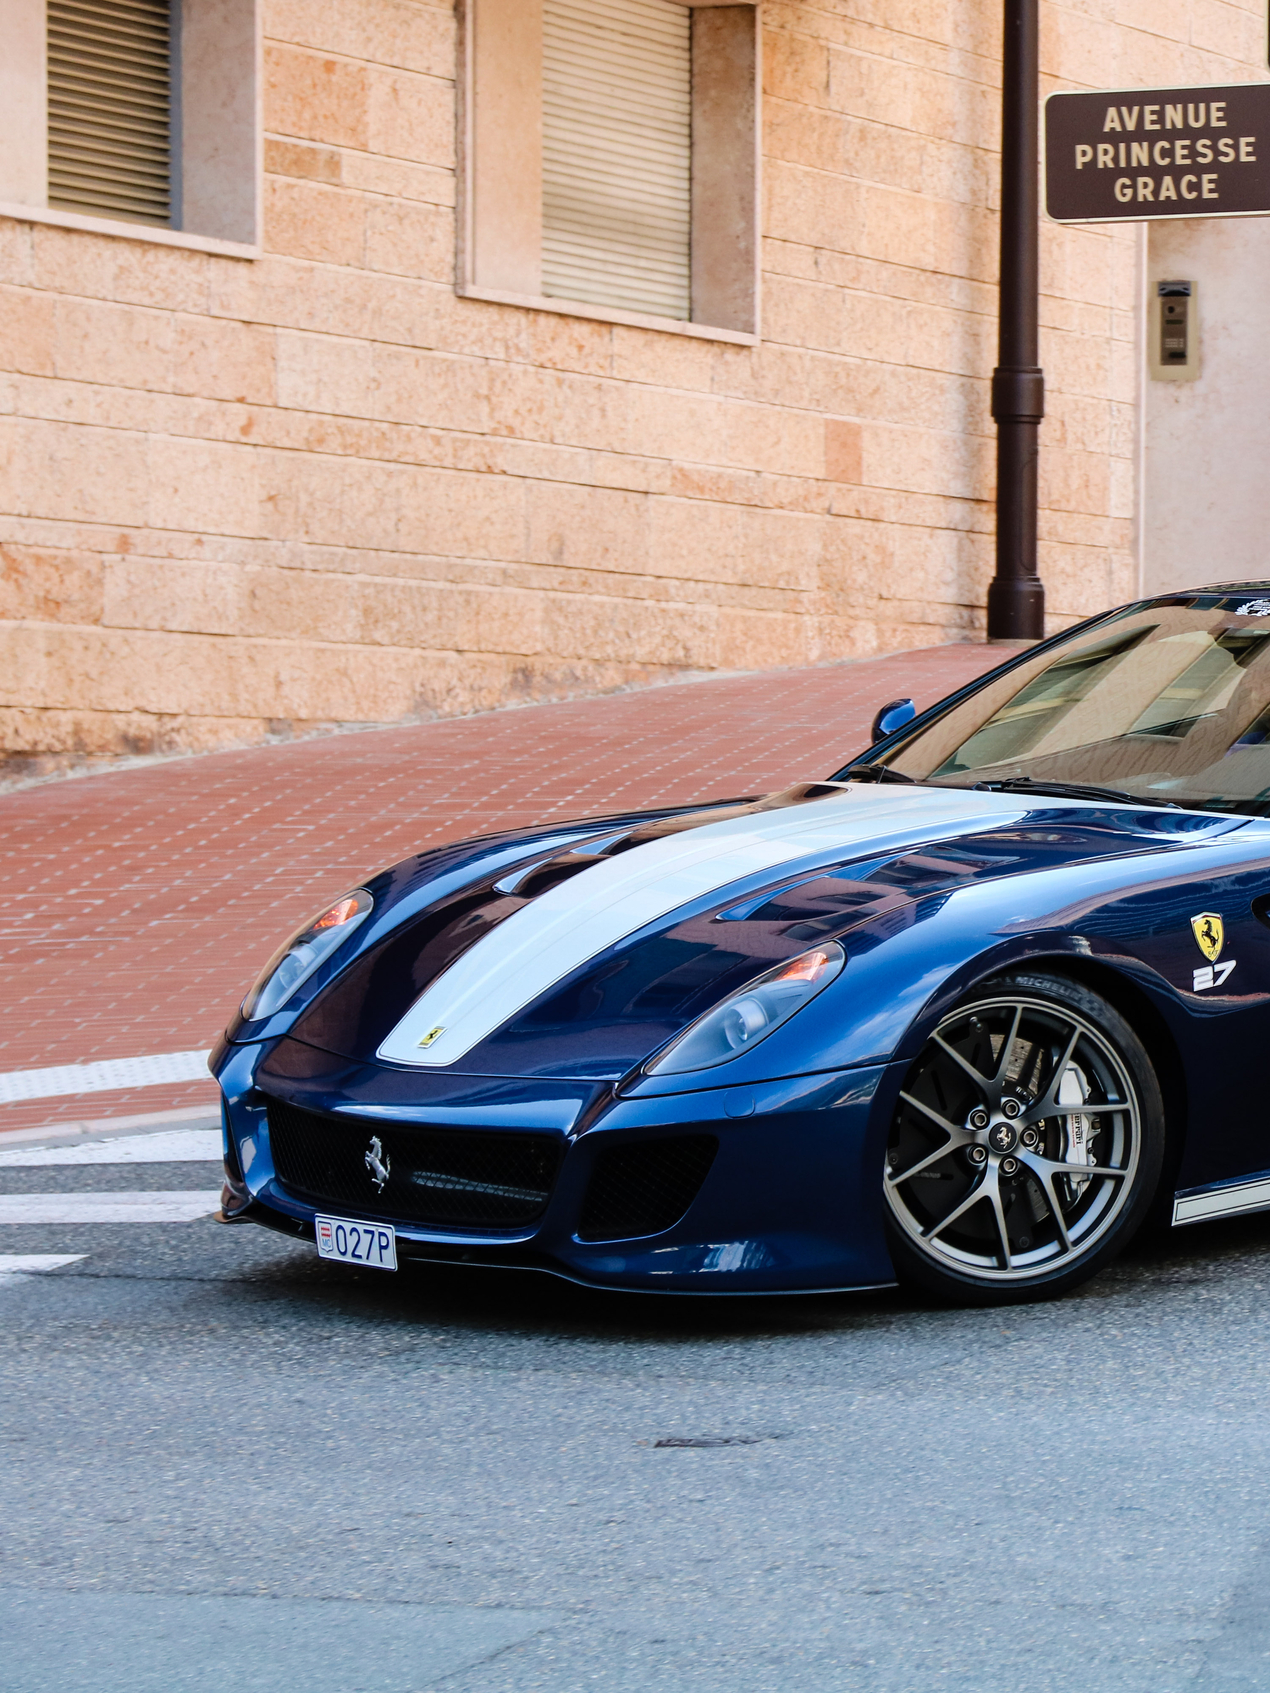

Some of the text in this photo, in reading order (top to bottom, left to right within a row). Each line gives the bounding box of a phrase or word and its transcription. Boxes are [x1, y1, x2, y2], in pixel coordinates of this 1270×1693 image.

[1103, 101, 1227, 132] AVENUE
[1075, 136, 1257, 170] PRINCESSE
[1114, 173, 1219, 203] GRACE
[1192, 959, 1237, 992] 27
[335, 1224, 390, 1263] 027P
